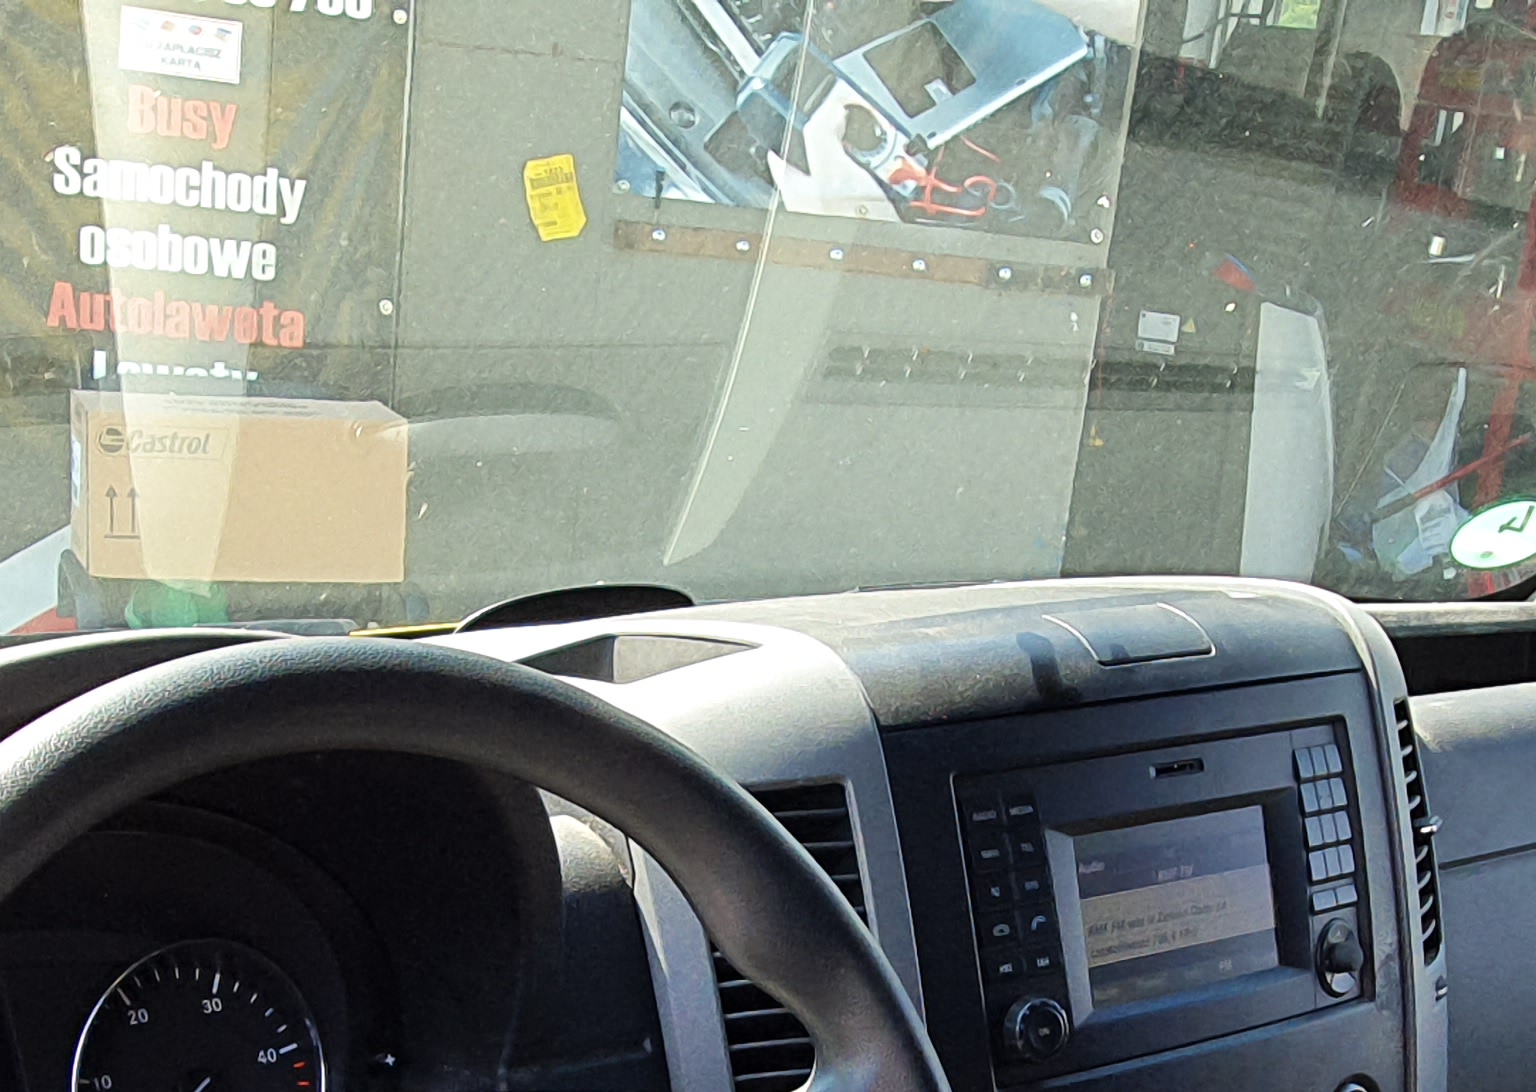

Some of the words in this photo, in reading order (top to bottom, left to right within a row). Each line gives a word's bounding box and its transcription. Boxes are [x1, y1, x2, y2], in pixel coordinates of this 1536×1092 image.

[126, 84, 237, 149] Busy
[52, 145, 306, 224] Samochody
[78, 224, 277, 281] osobowe
[46, 281, 305, 348] Autolaweta
[126, 429, 211, 456] Castrol
[128, 1008, 149, 1025] 20
[202, 998, 222, 1014] 30
[257, 1048, 277, 1063] 40
[93, 1074, 112, 1090] 10
